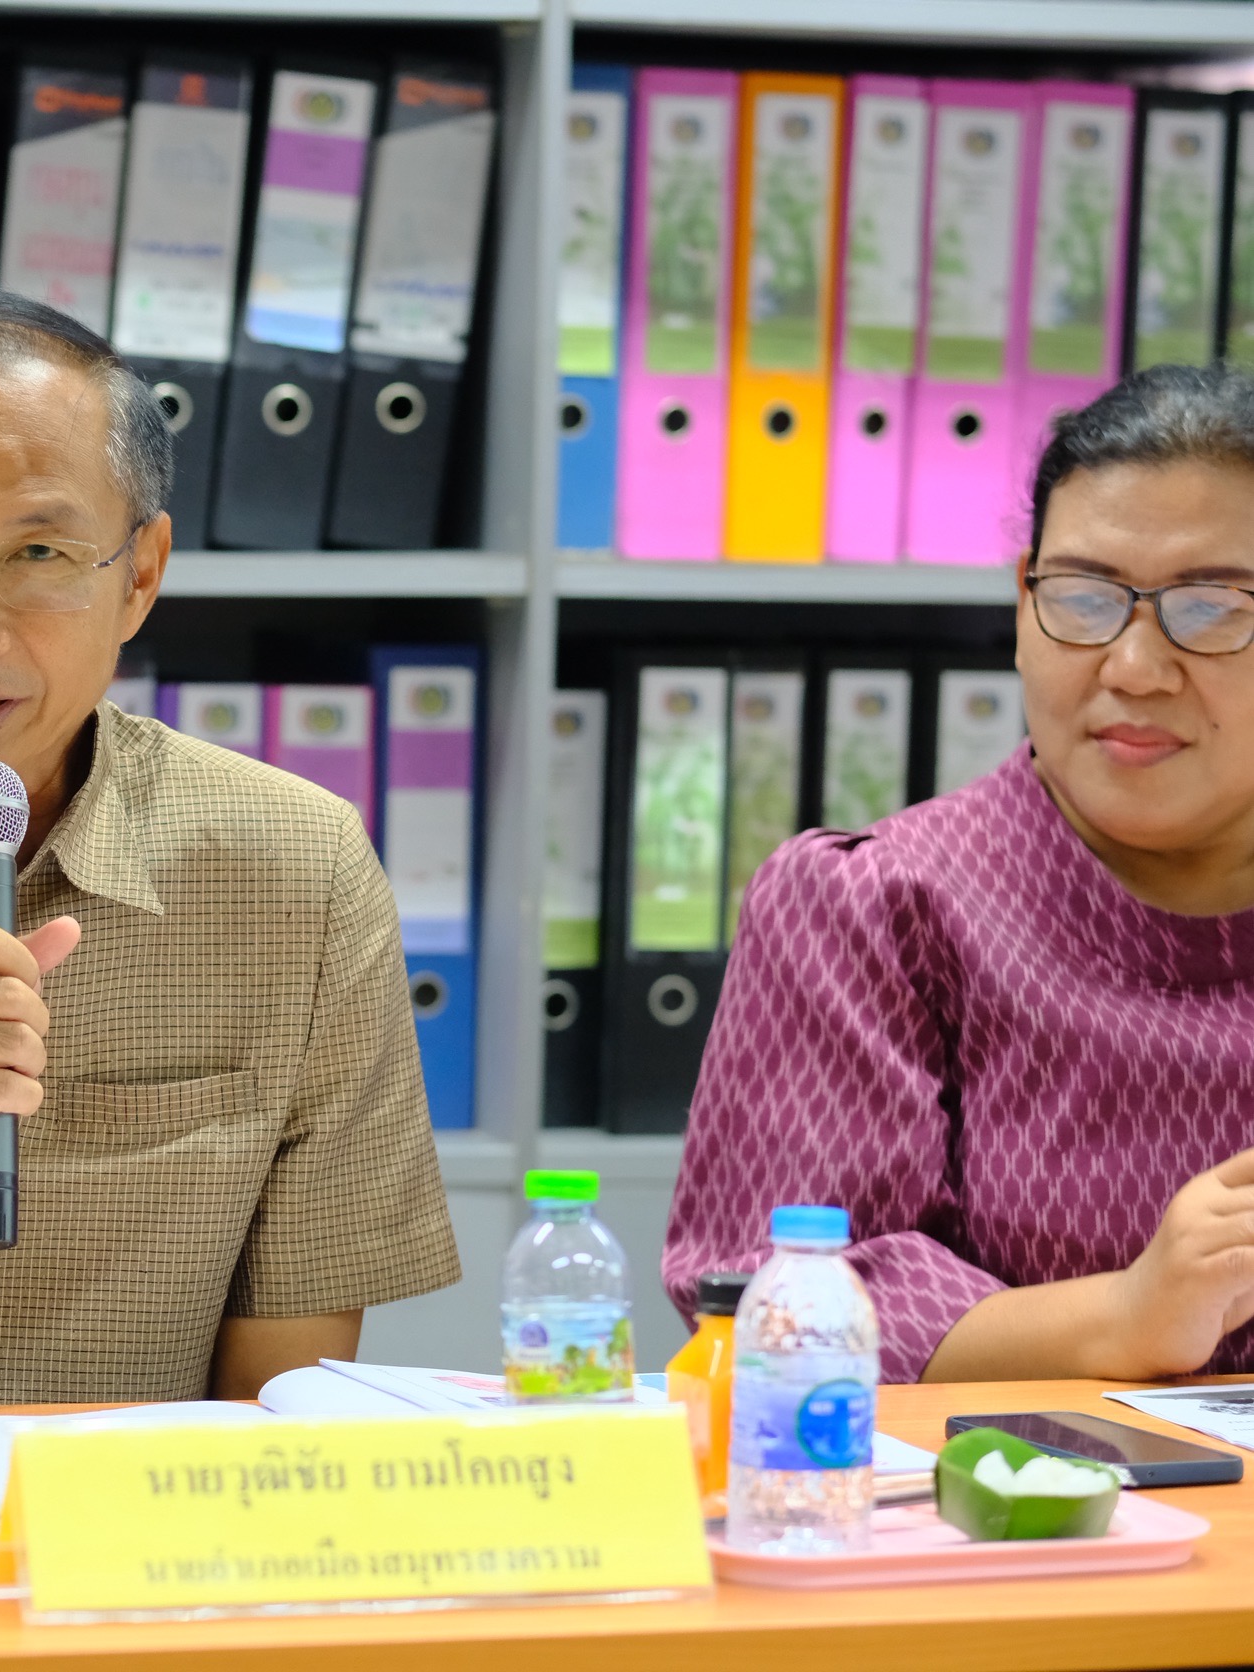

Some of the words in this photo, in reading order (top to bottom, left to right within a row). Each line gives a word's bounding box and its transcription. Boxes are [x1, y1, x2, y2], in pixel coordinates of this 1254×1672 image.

[147, 1444, 347, 1508] นายวุฒิชัย
[373, 1438, 575, 1500] ยามโคกสูง
